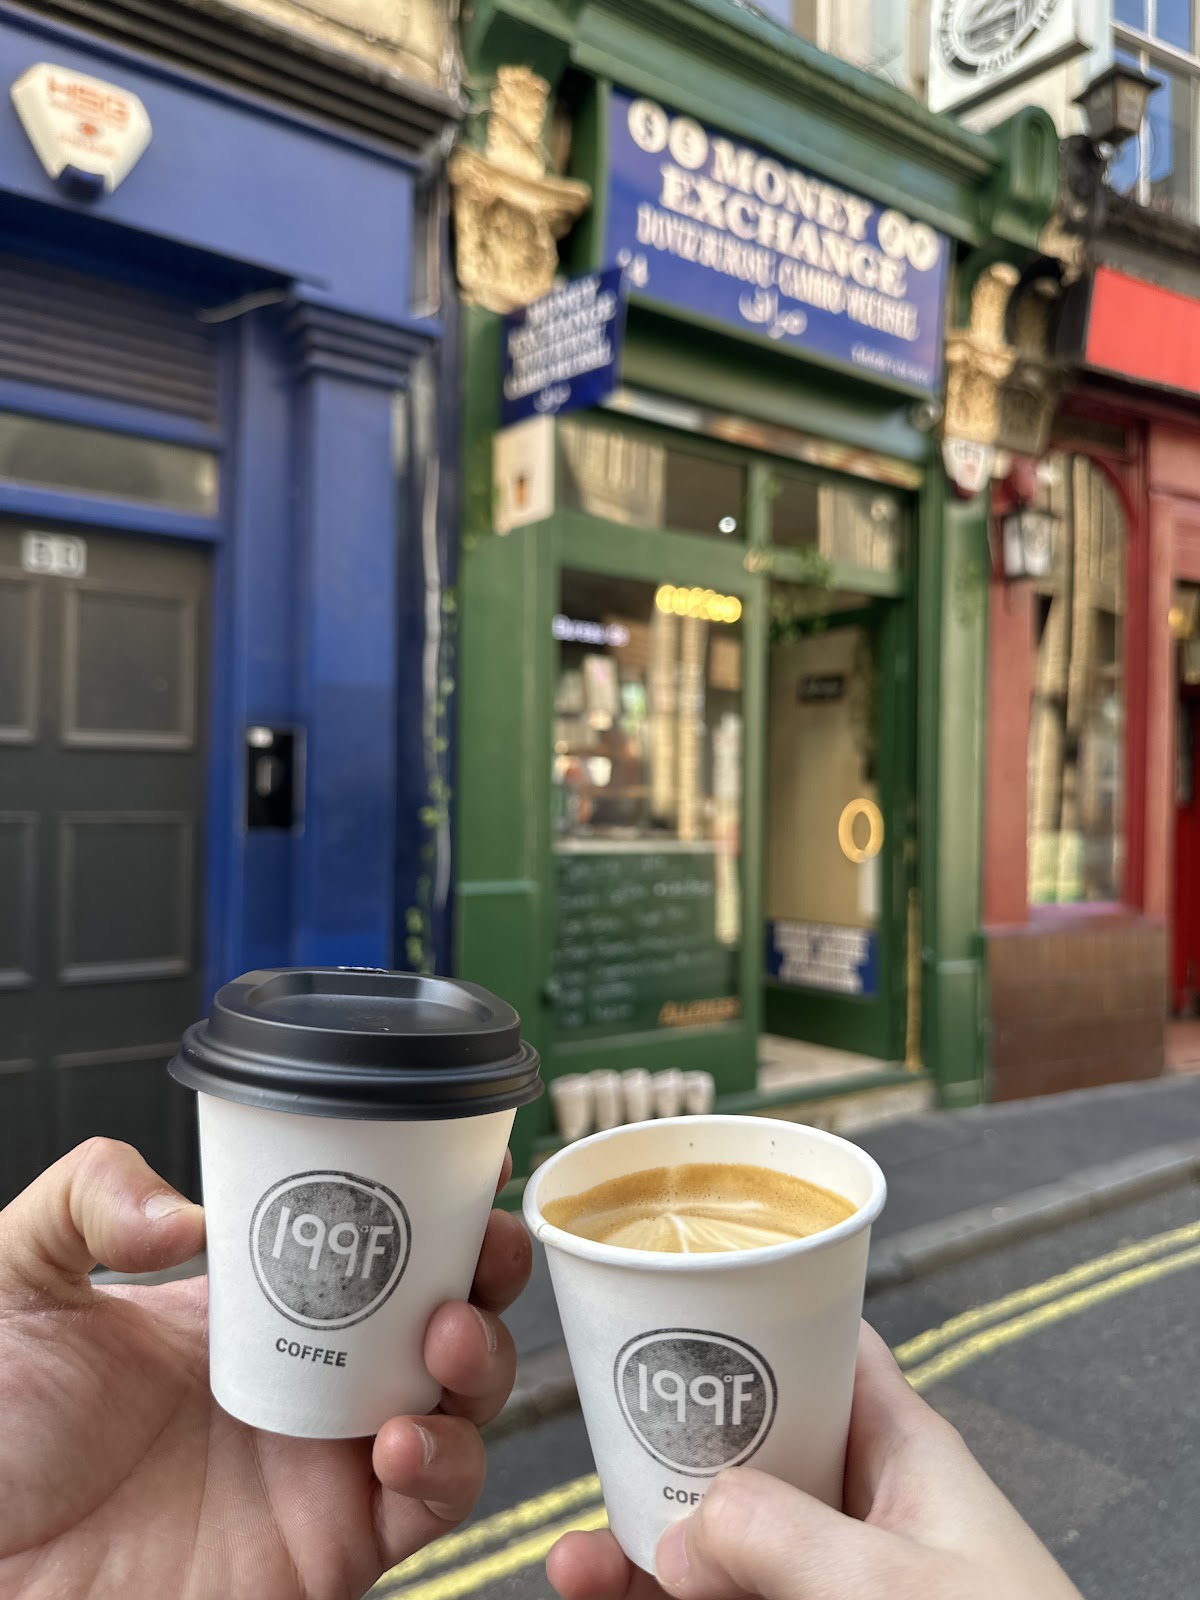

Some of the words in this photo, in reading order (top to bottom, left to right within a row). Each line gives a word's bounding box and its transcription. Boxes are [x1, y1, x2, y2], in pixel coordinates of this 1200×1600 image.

[711, 138, 874, 241] MONEY
[660, 163, 908, 299] EXCHANGE
[275, 1337, 348, 1368] COFFEE
[662, 1486, 704, 1506] COF
